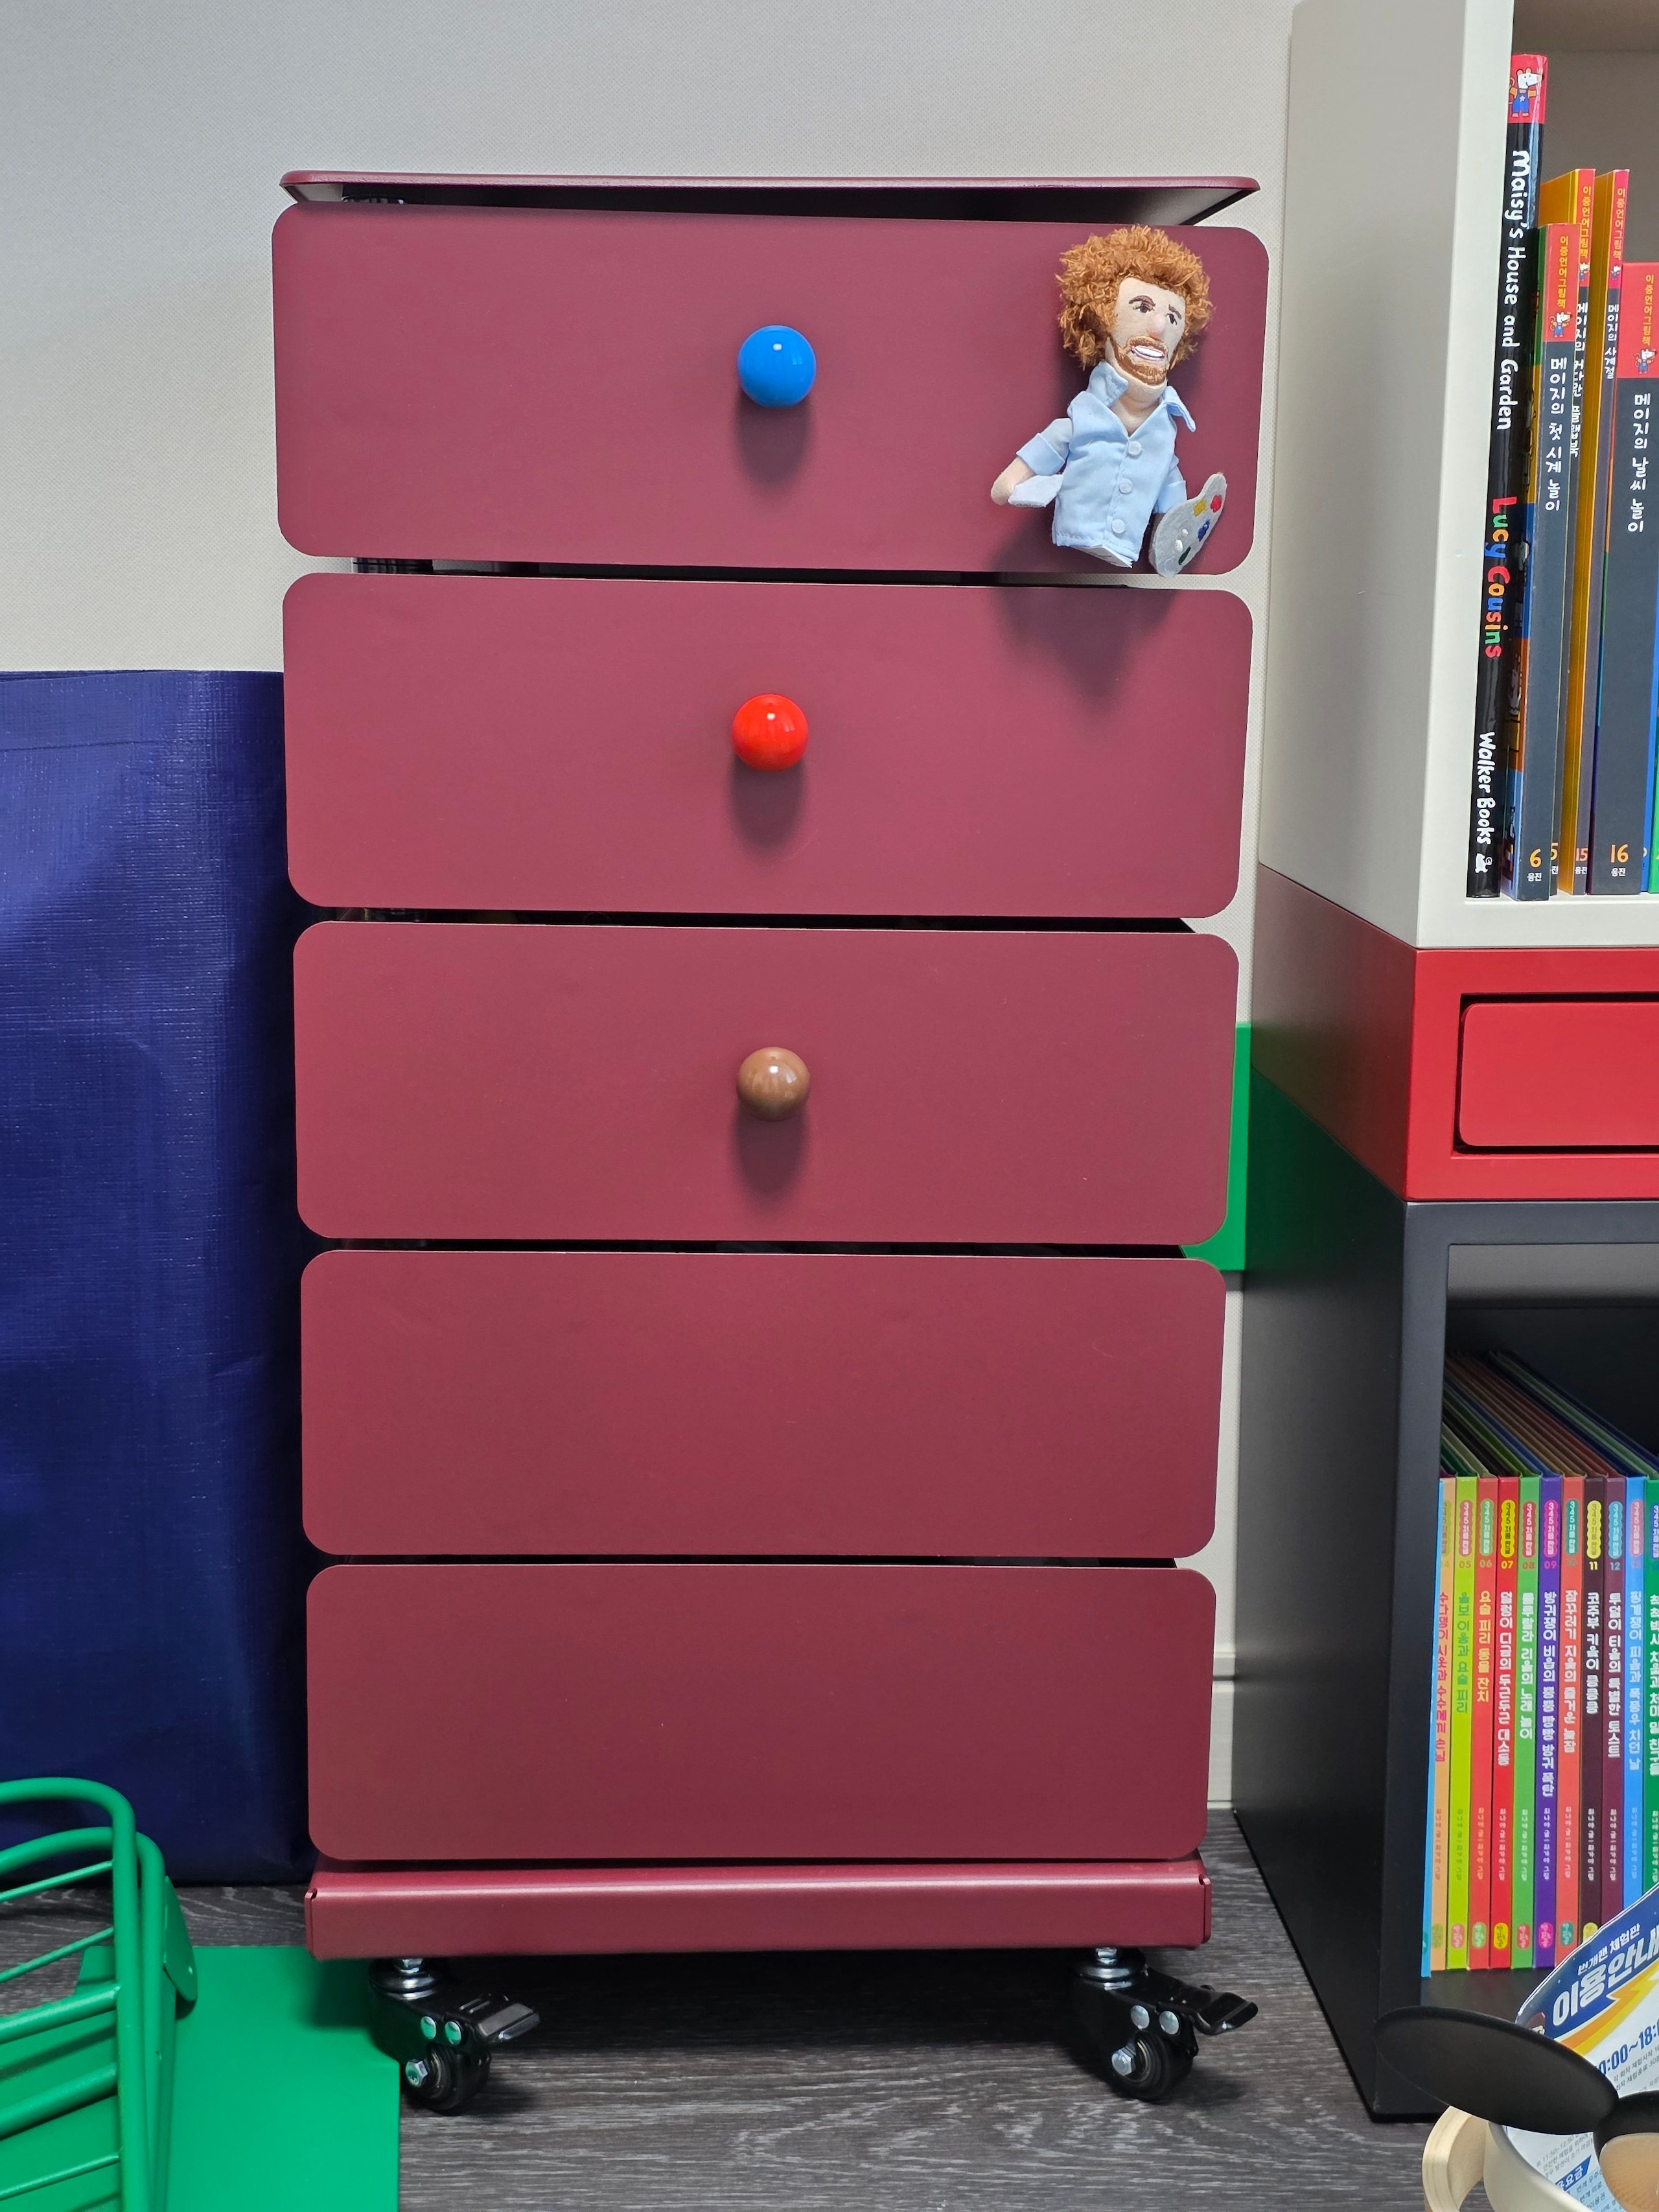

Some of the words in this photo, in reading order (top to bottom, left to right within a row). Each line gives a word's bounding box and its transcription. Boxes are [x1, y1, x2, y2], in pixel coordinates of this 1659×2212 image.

[1502, 149, 1530, 238] Maisy's
[1503, 246, 1527, 305] House
[1502, 315, 1520, 347] and
[1575, 302, 1588, 351] 메이지의
[1607, 304, 1619, 342] 메이지의
[1604, 347, 1617, 380] 사계절
[1496, 358, 1518, 431] Garden
[1549, 357, 1567, 415] 메이지의
[1548, 423, 1562, 441] 첫
[1633, 393, 1651, 450] 메이지의
[1545, 447, 1562, 474] 시계
[1630, 456, 1649, 491] 날씨
[1545, 479, 1560, 511] 놀이
[1484, 496, 1518, 559] Lucy
[1627, 498, 1645, 533] 놀이
[1485, 565, 1511, 658] Cousins
[1478, 732, 1496, 794] Walker
[1476, 797, 1496, 845] Books
[1529, 848, 1542, 868] 6
[1575, 848, 1588, 861] 15
[1610, 844, 1629, 863] 16
[1527, 872, 1542, 882] 웅진
[1551, 866, 1559, 875] 진
[1575, 867, 1587, 875] 웅진
[1611, 868, 1627, 877] 웅진
[1479, 1559, 1492, 1568] 06
[1501, 1560, 1514, 1569] 07
[1523, 1561, 1535, 1570] 08
[1544, 1561, 1557, 1570] 09
[1589, 1561, 1598, 1570] 11
[1610, 1562, 1621, 1570] 12
[1479, 1591, 1491, 1615] 요술
[1587, 1592, 1599, 1629] 코주부
[1608, 1593, 1621, 1630] 투덜이
[1457, 1621, 1469, 1657] 이응과
[1479, 1620, 1491, 1644] 피리
[1478, 1648, 1490, 1673] 동물
[1500, 1633, 1511, 1670] 디귿의
[1457, 1661, 1468, 1685] 요술
[1457, 1690, 1468, 1713] 피리
[1477, 1677, 1489, 1702] 잔치
[1499, 1675, 1511, 1724] 두근두근
[1520, 1688, 1532, 1712] 노래
[1564, 1687, 1575, 1723] 즐거운
[1608, 1678, 1620, 1716] 특별한
[1436, 1686, 1446, 1733] 수수께끼
[1629, 1688, 1640, 1725] 폭풍우
[1520, 1716, 1532, 1739] 놀이
[1608, 1721, 1620, 1757] 토스트
[1629, 1729, 1640, 1754] 치던
[1433, 1737, 1446, 1763] 손님
[1498, 1729, 1509, 1765] 대소동
[1629, 1758, 1640, 1770] 날
[1610, 1923, 1640, 1953] 체험관
